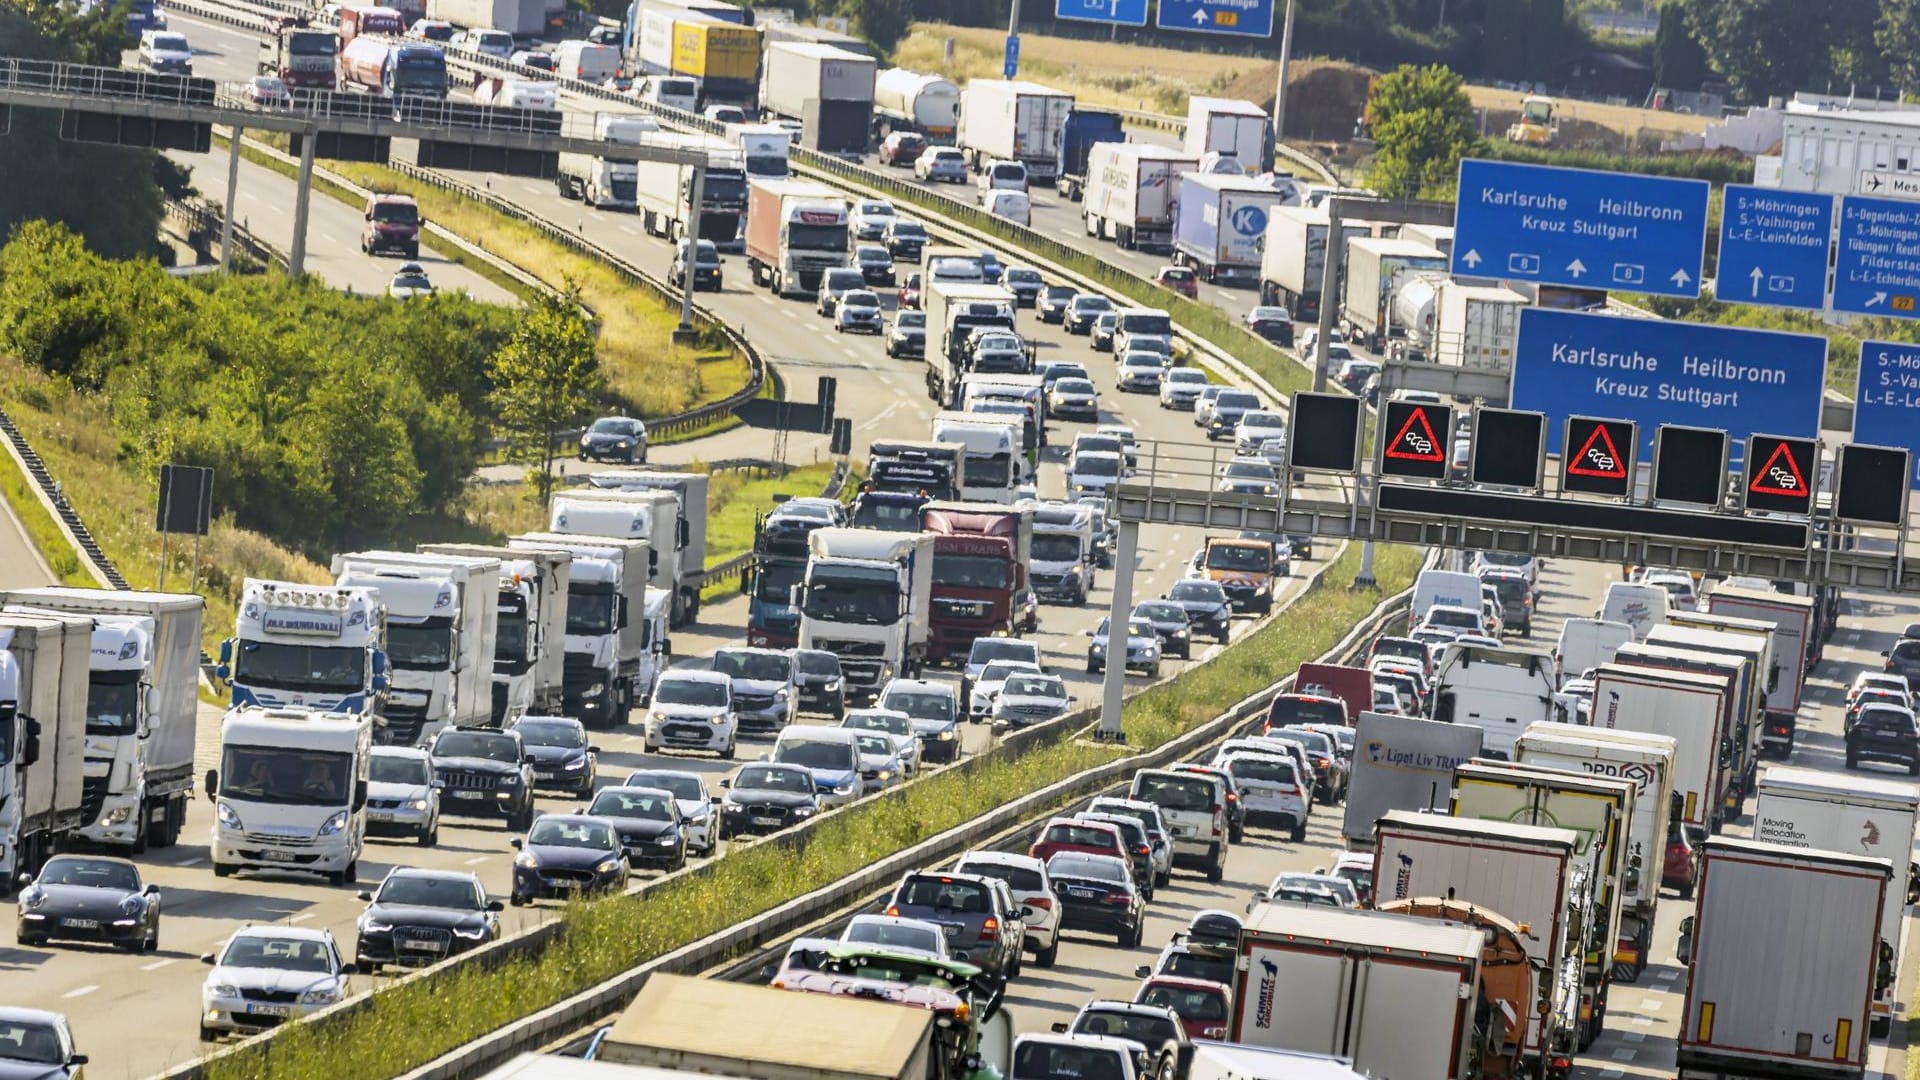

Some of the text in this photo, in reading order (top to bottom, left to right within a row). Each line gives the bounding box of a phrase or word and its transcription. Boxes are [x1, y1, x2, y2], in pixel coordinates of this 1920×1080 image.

[1893, 180, 1920, 193] Mes
[1481, 187, 1683, 221] Karlsruhe Heilbronn
[1738, 197, 1820, 218] S.-Möhringen
[1522, 215, 1638, 241] Kreuz Stuttgart
[1739, 213, 1816, 232] S.-Vaihingen
[1728, 227, 1823, 247] L.-E.-Leinfelden
[1520, 258, 1529, 269] 8
[1624, 268, 1633, 279] 8
[1551, 343, 1786, 385] Karlsruhe Heilbronn
[1879, 371, 1920, 389] S.-Va
[1595, 377, 1739, 409] Kreuz Stuttgart
[1416, 751, 1433, 766] Liv
[1582, 762, 1617, 777] DPD
[1760, 827, 1806, 839] Relocation
[1762, 818, 1794, 830] Moving
[1256, 977, 1270, 1029] SCHMITZ
[1263, 979, 1276, 1030] CARGOBULL
